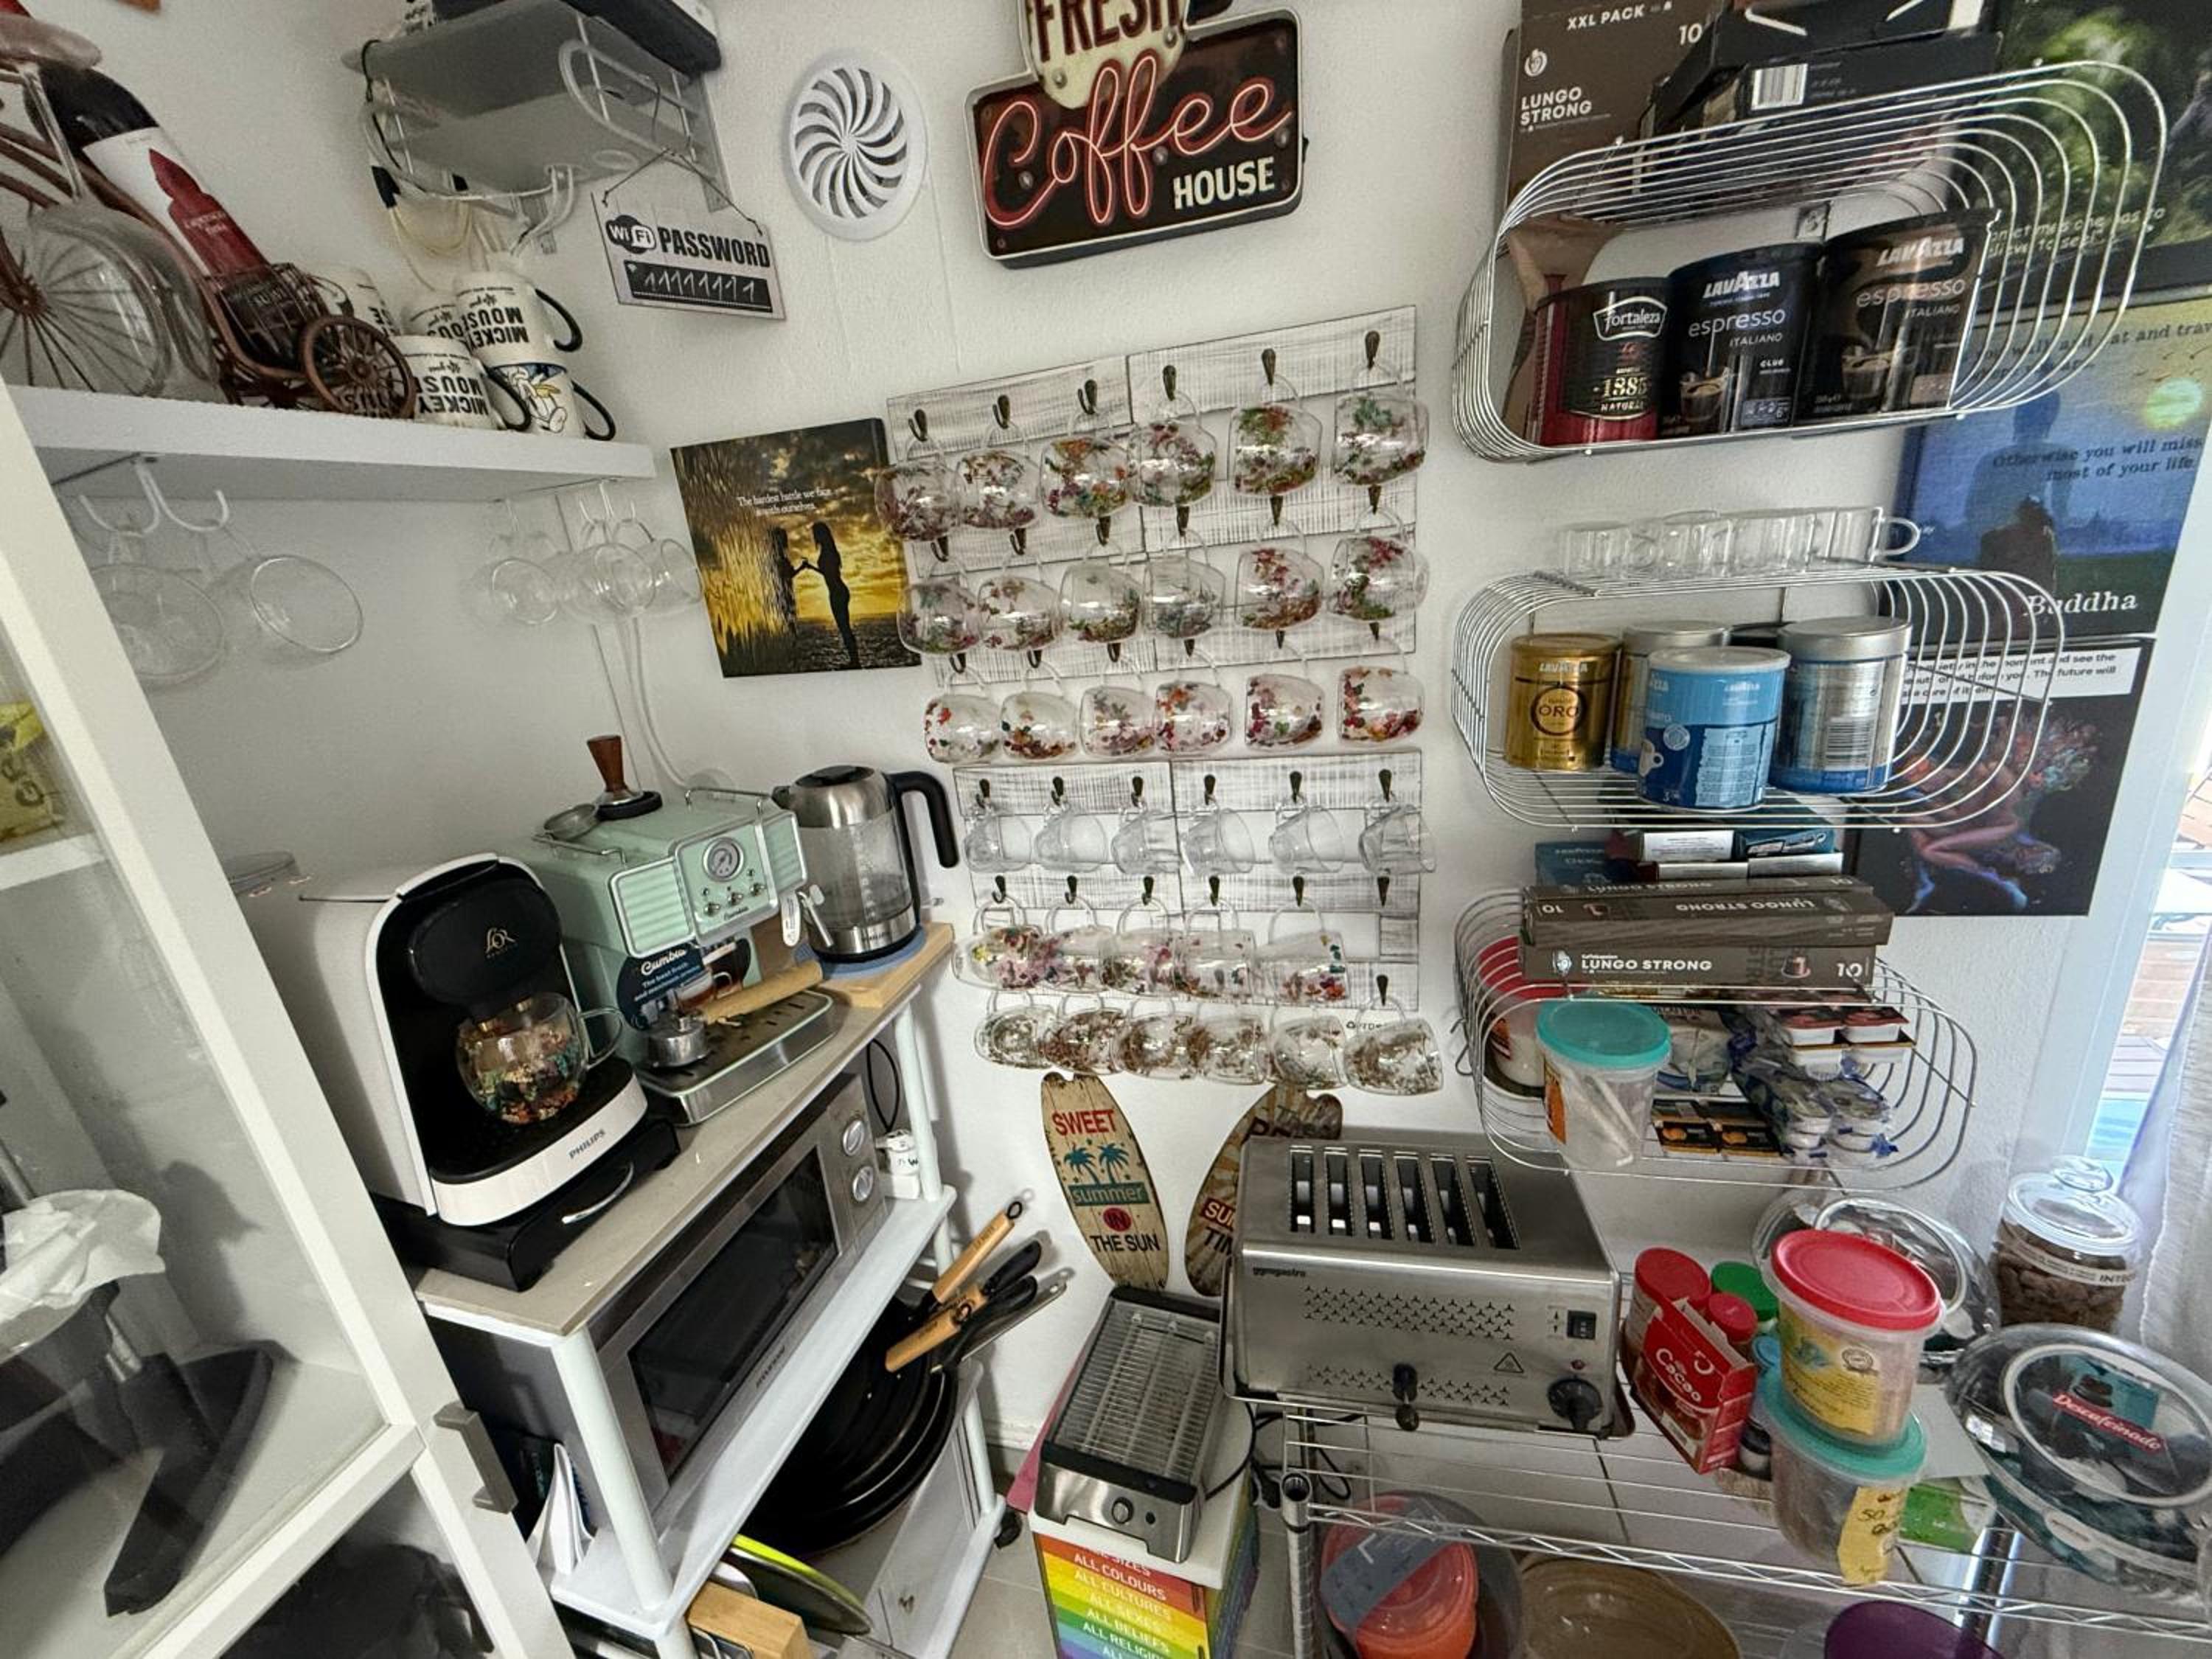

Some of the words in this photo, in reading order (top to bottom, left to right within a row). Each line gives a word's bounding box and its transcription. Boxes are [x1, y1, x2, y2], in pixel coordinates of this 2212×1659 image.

[1567, 13, 1596, 31] XXL
[1600, 4, 1646, 24] PACK
[1678, 23, 1703, 45] 10
[1521, 86, 1582, 110] LUNGO
[1520, 100, 1593, 125] STRONG
[981, 47, 1292, 229] Coffee
[1173, 156, 1276, 210] HOUSE
[657, 227, 770, 268] PASSWORD
[1877, 237, 1965, 268] LAVAZZA
[1703, 271, 1781, 299] LAVAZZA
[1688, 309, 1786, 341] espresso
[2135, 324, 2170, 342] and
[1730, 333, 1783, 347] ITALIANO
[419, 395, 489, 416] MICKEY
[1992, 448, 2079, 468] Otherwise
[2085, 446, 2115, 462] you
[2123, 439, 2155, 455] will
[2160, 438, 2202, 451] miss
[2046, 467, 2089, 482] most
[2096, 463, 2113, 478] of
[2118, 462, 2160, 479] your
[2023, 591, 2138, 617] Buddha
[1539, 705, 1579, 717] ORO
[1675, 901, 1748, 912] STRONG
[1750, 898, 1817, 911] LUNGO
[641, 949, 686, 975] Cumbia
[1581, 959, 1638, 970] LUNGO
[1642, 959, 1713, 971] STRONG
[1835, 962, 1863, 978] 10
[1051, 1109, 1116, 1136] SWEET
[568, 1128, 605, 1160] PHILIPS
[1072, 1186, 1144, 1203] summer
[1090, 1235, 1124, 1252] THE
[1125, 1234, 1161, 1252] SUN
[1656, 1348, 1702, 1402] Cacao
[1074, 1554, 1099, 1572] ALL
[1102, 1565, 1166, 1601] COLOURS
[1074, 1568, 1099, 1587] ALL
[1082, 1622, 1104, 1640] ALL
